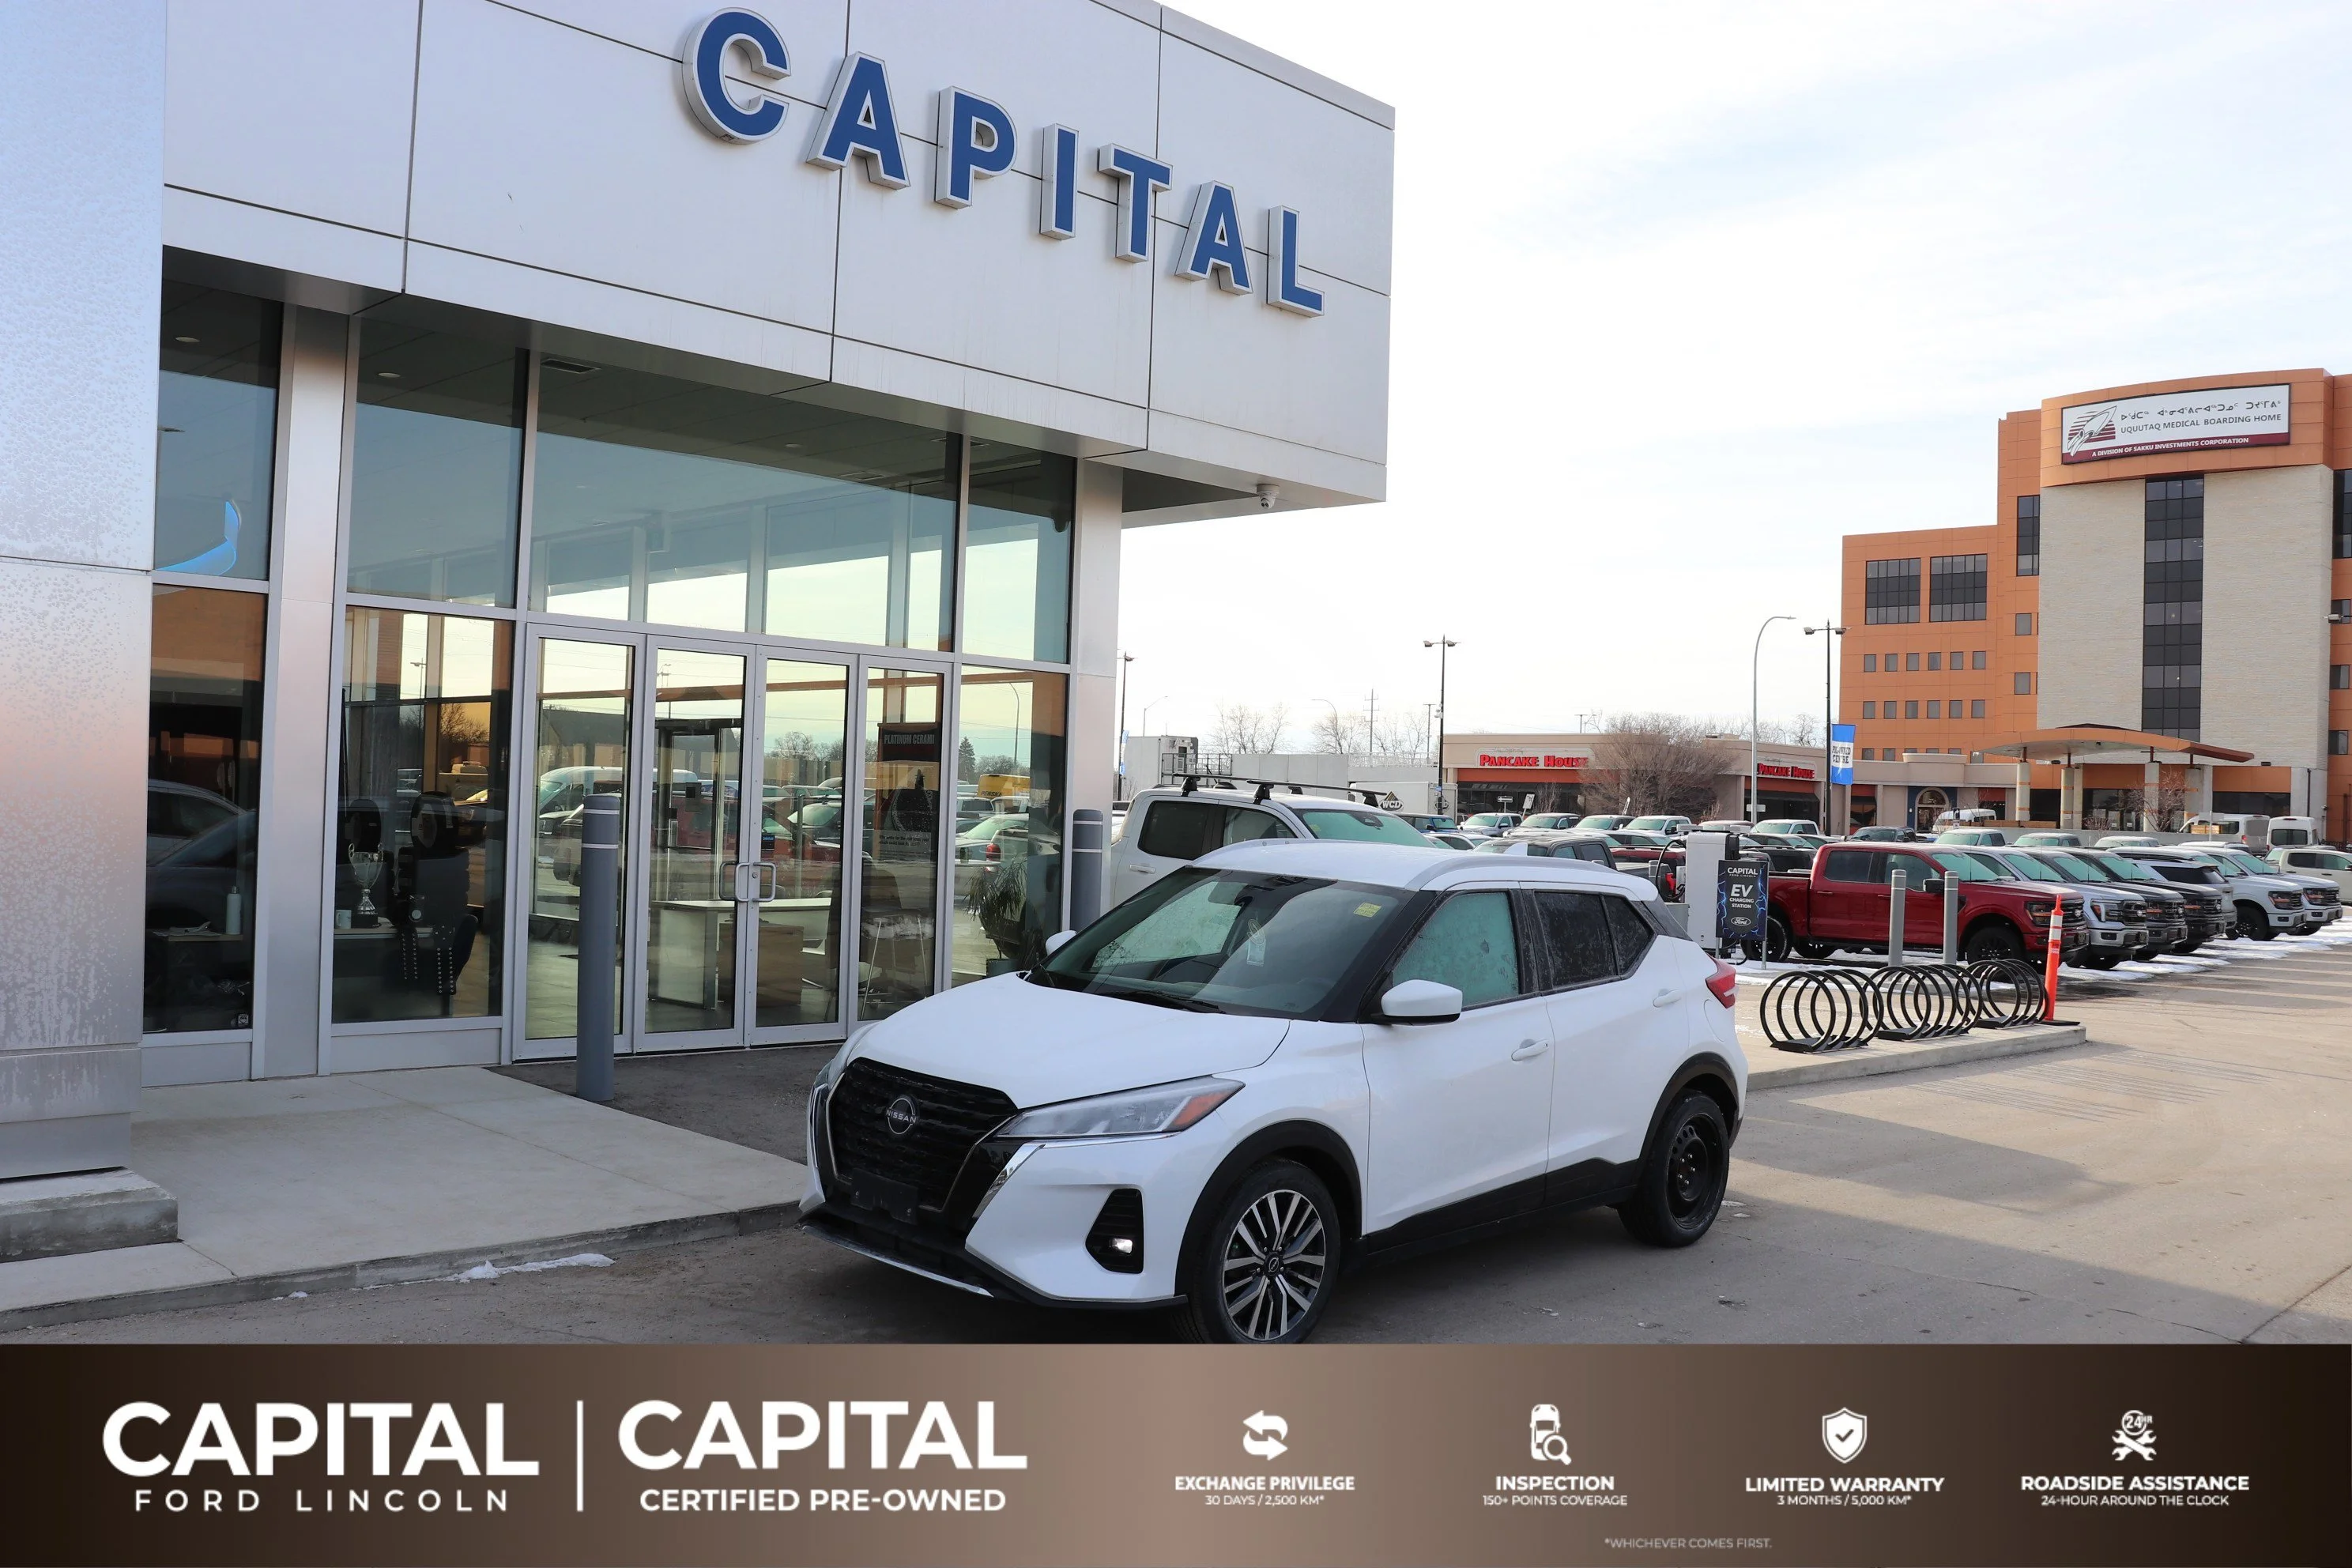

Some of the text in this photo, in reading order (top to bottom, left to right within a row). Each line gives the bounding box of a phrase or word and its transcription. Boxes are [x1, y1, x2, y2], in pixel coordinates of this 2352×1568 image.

[682, 7, 1325, 318] CAPITAL
[2120, 423, 2161, 434] UQUUTAQ
[2163, 420, 2200, 428] MEDICAL
[2203, 416, 2251, 425] BOARDING
[2154, 441, 2199, 450] INVESTMENTS
[2199, 437, 2249, 447] CORPORATION
[884, 734, 936, 744] PLATINUM CERAMI
[1479, 755, 1589, 767] PANCAKE HOUSE
[1757, 763, 1815, 779] PANCAKE HOUSE
[1382, 800, 1401, 808] WCD
[1730, 884, 1754, 898] EV
[886, 1109, 917, 1123] NISSAN
